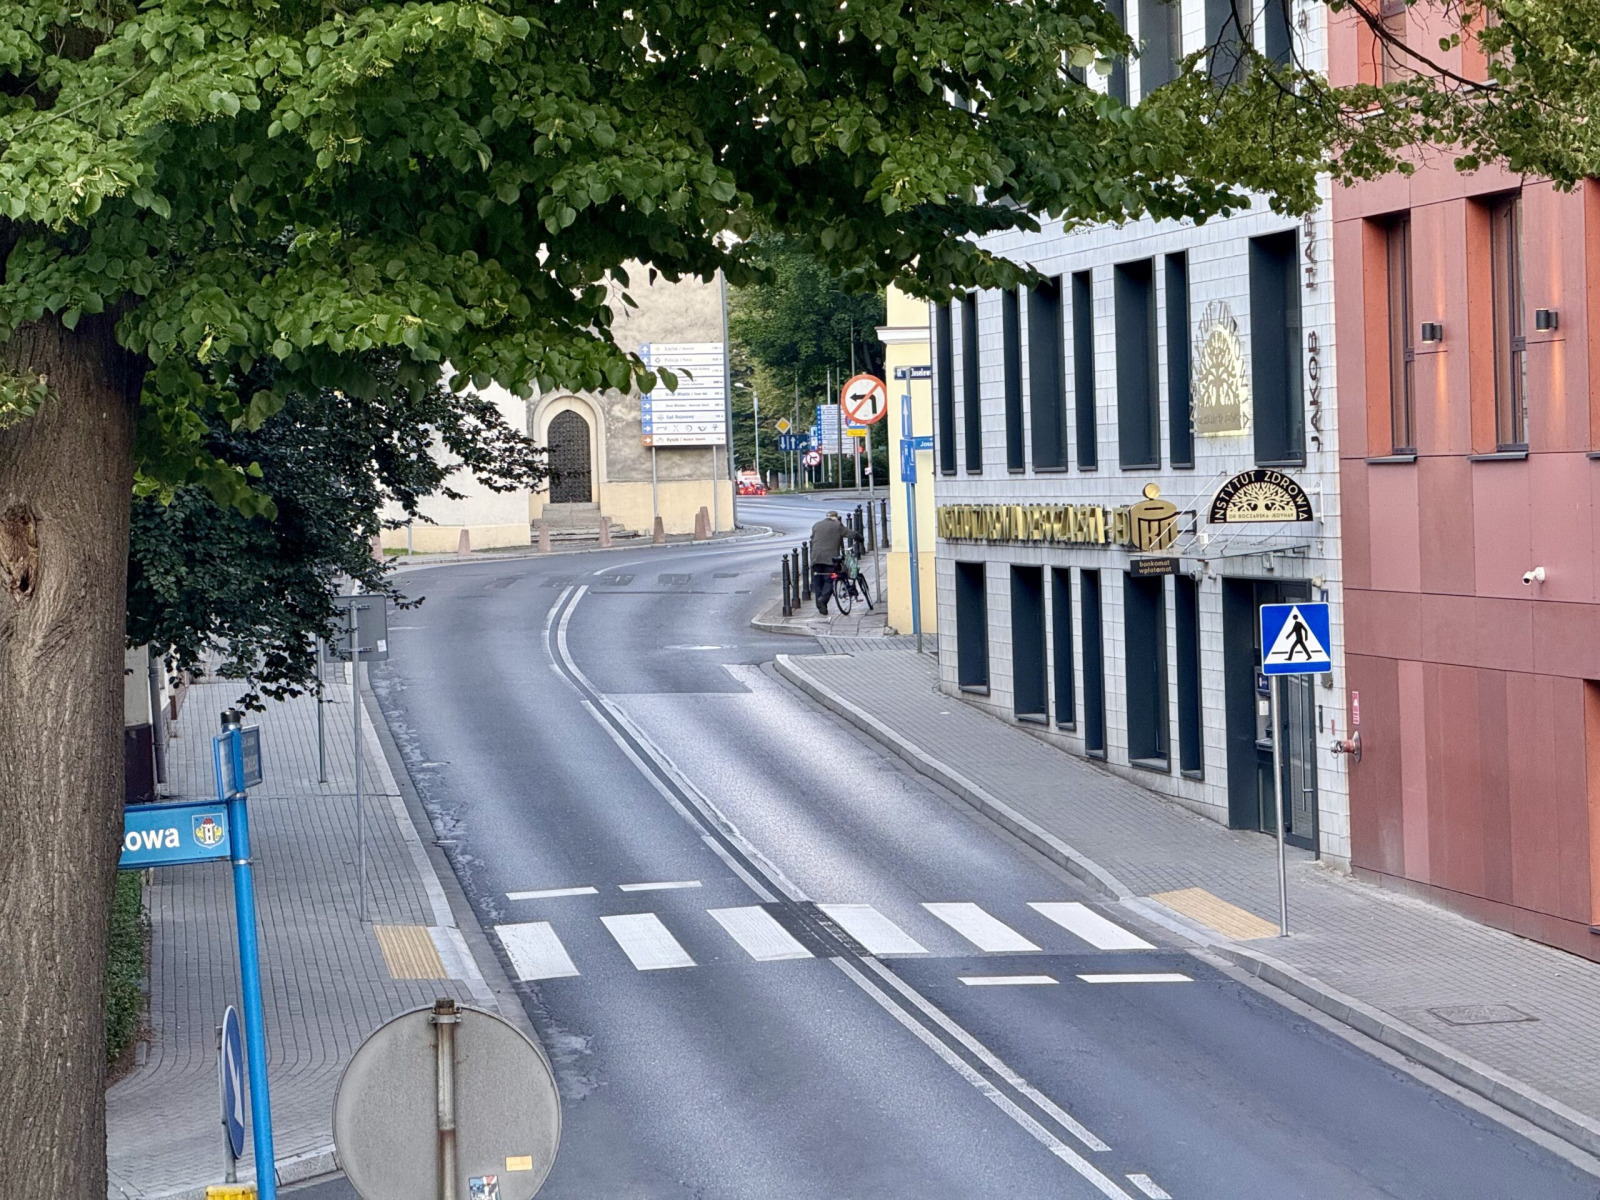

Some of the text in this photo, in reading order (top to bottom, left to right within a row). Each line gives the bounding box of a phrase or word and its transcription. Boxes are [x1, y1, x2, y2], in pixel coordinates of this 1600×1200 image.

[1308, 331, 1321, 452] JAKOB
[1214, 471, 1309, 522] INSTYTUT ZDROWIA
[120, 828, 180, 851] owa
